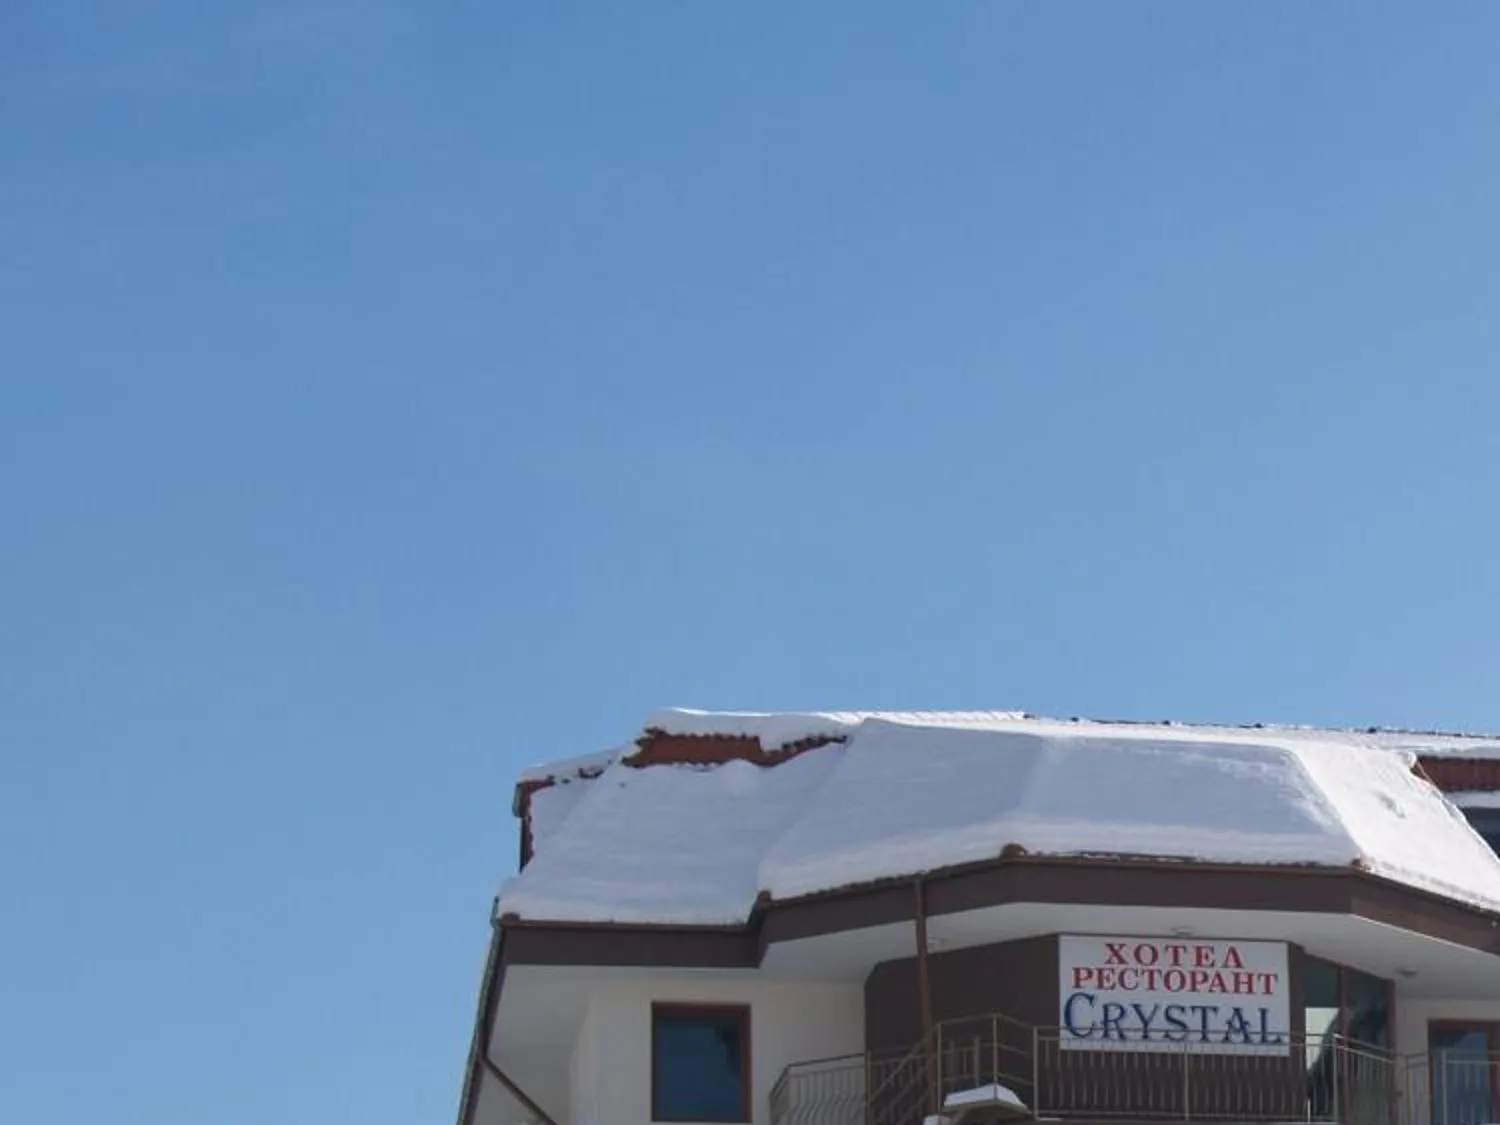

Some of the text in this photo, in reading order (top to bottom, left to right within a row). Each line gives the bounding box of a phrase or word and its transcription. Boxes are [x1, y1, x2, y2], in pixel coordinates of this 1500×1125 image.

[1104, 943, 1245, 968] ХОТЕЛ
[1072, 967, 1278, 995] РЕСТОРАНТ
[1063, 992, 1282, 1044] CRYSTAL
